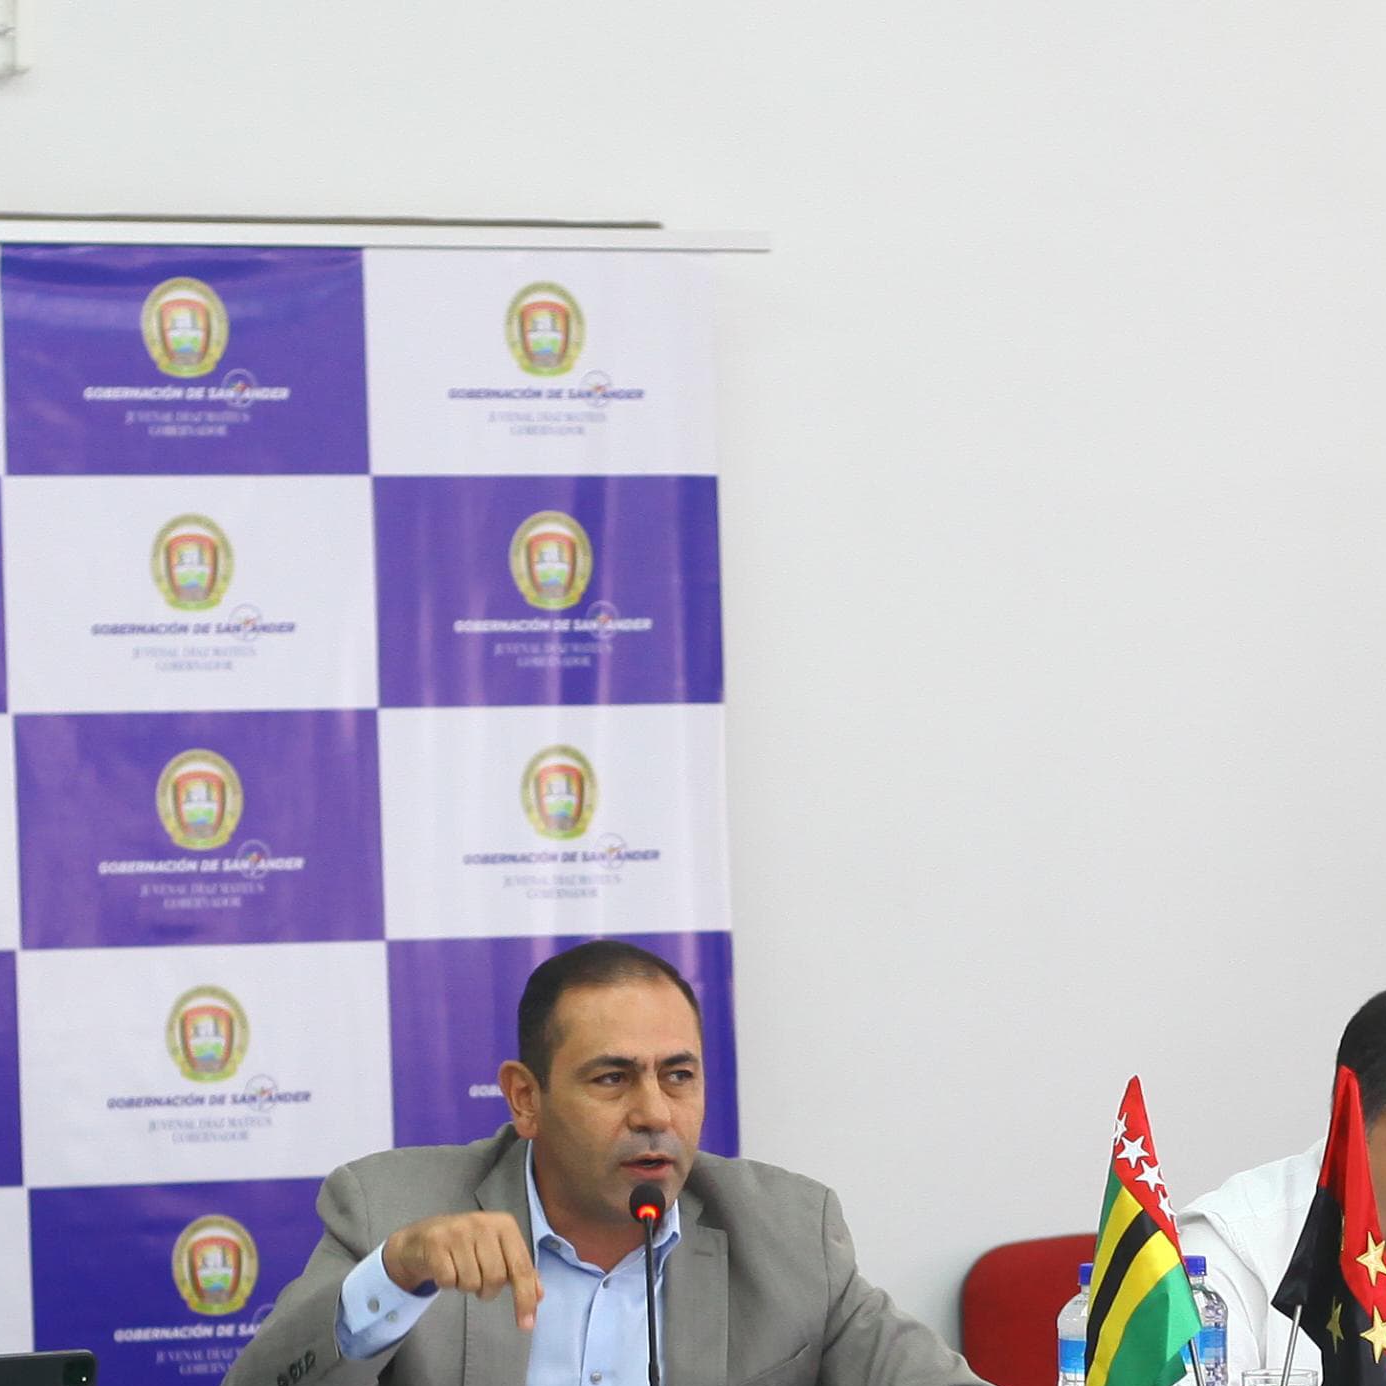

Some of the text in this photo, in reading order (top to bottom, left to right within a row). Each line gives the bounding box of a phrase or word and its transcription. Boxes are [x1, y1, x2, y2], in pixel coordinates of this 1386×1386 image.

[185, 387, 205, 400] DE
[192, 623, 209, 634] DE
[200, 859, 219, 872] DE
[107, 1089, 311, 1109] GOBERNACIÓN DE SANTANDER
[216, 1324, 235, 1337] DE
